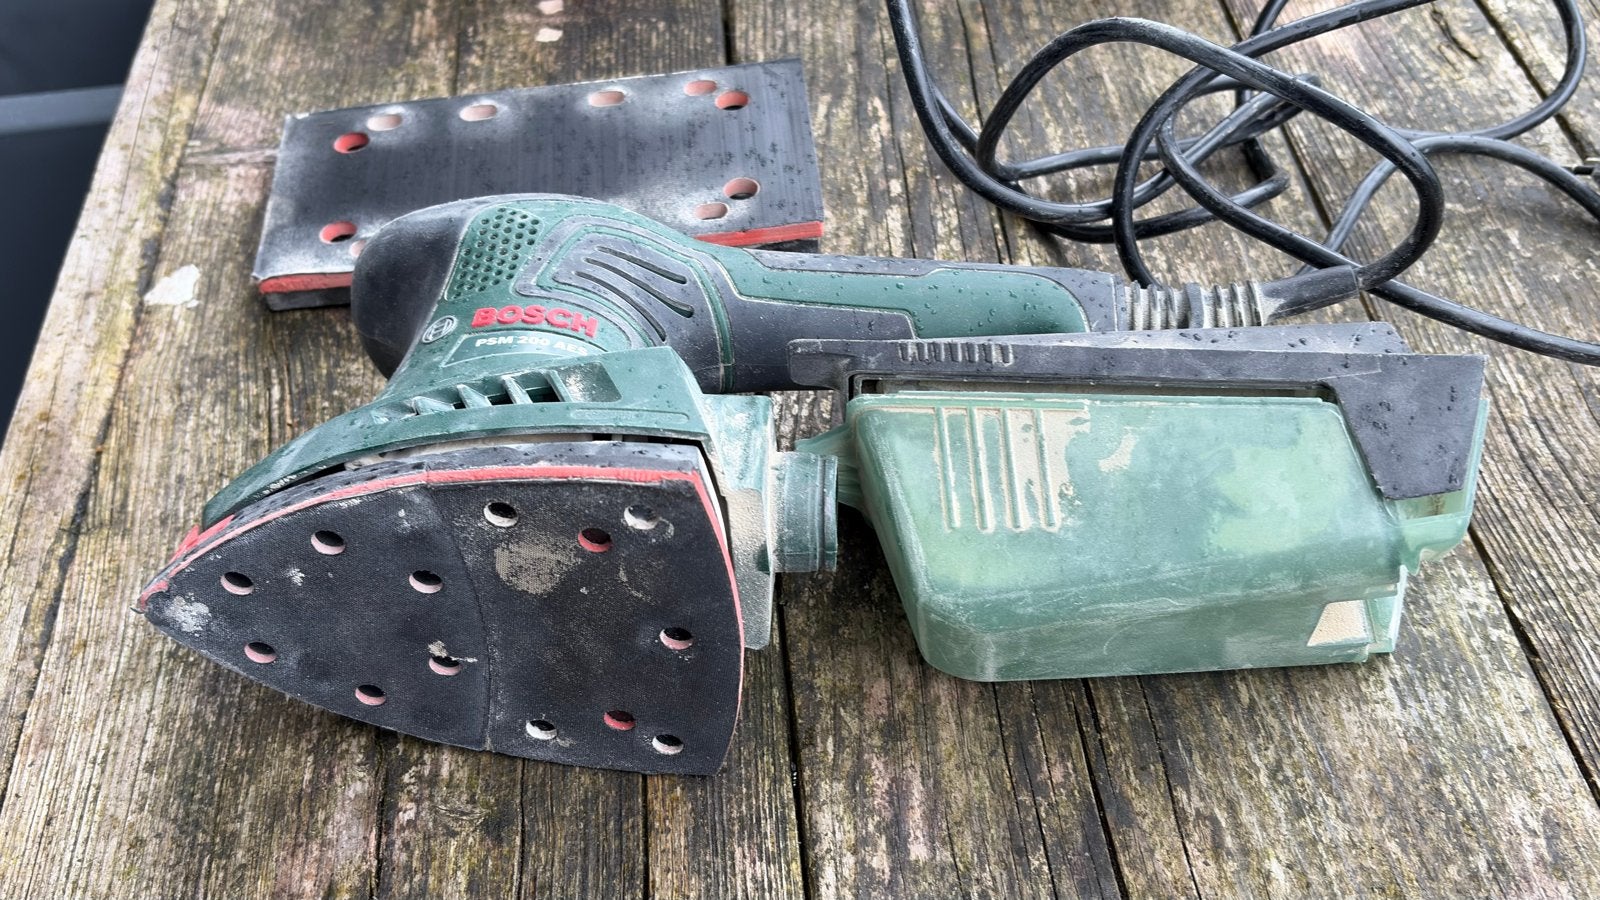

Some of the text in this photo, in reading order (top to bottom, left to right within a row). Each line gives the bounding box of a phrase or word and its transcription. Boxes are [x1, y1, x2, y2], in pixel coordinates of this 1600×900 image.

[471, 305, 599, 338] BOSCH
[475, 335, 589, 356] PSM 200 AES
